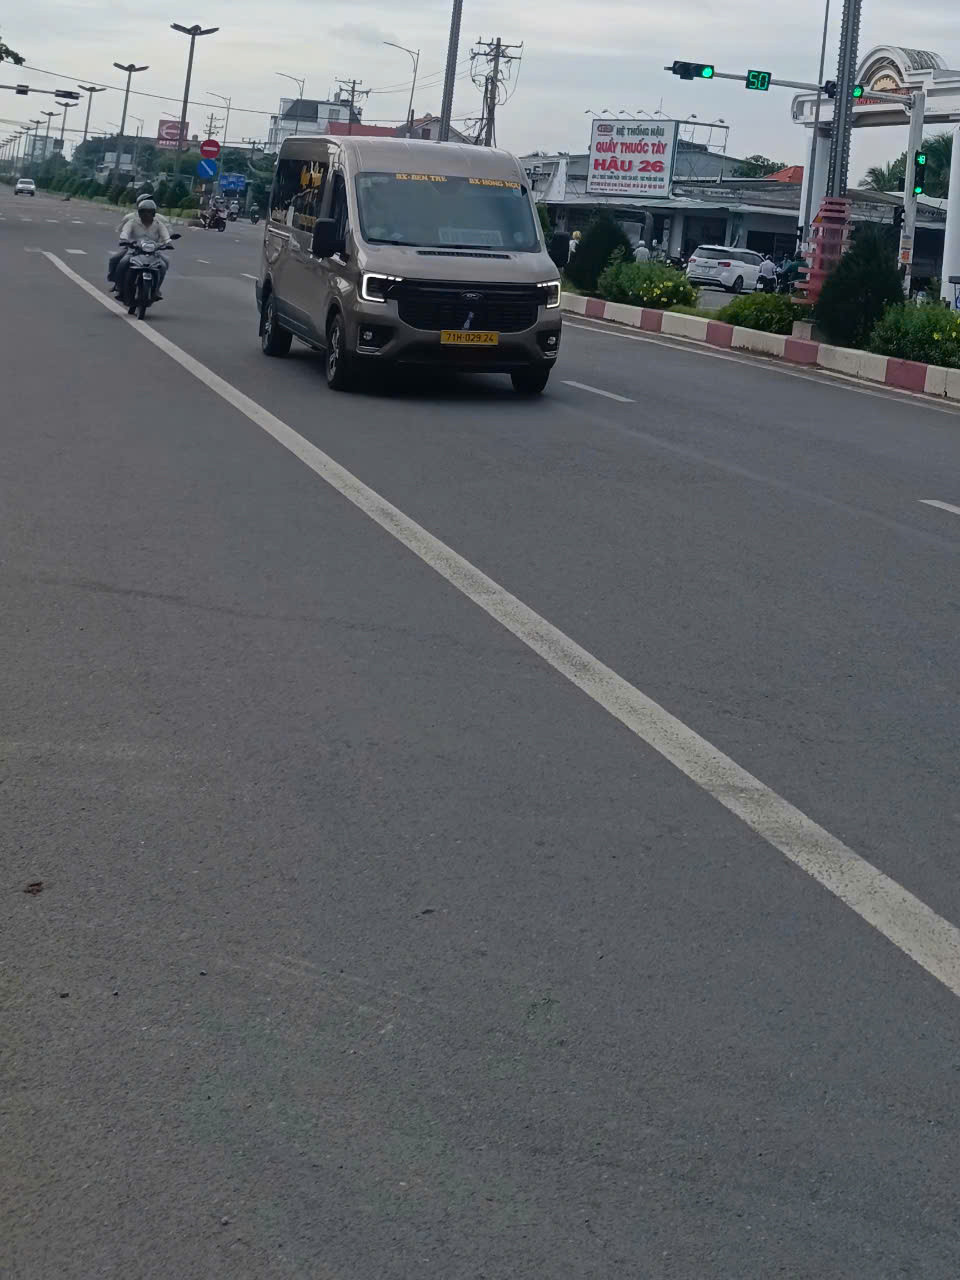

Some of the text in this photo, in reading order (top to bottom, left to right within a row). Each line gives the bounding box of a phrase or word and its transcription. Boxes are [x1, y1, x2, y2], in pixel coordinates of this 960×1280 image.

[749, 72, 769, 90] 50
[616, 125, 626, 138] HỆ
[627, 124, 650, 137] THỐNG
[620, 138, 650, 154] THUỐC
[651, 140, 668, 155] TÂY
[593, 156, 665, 175] HẬU 26
